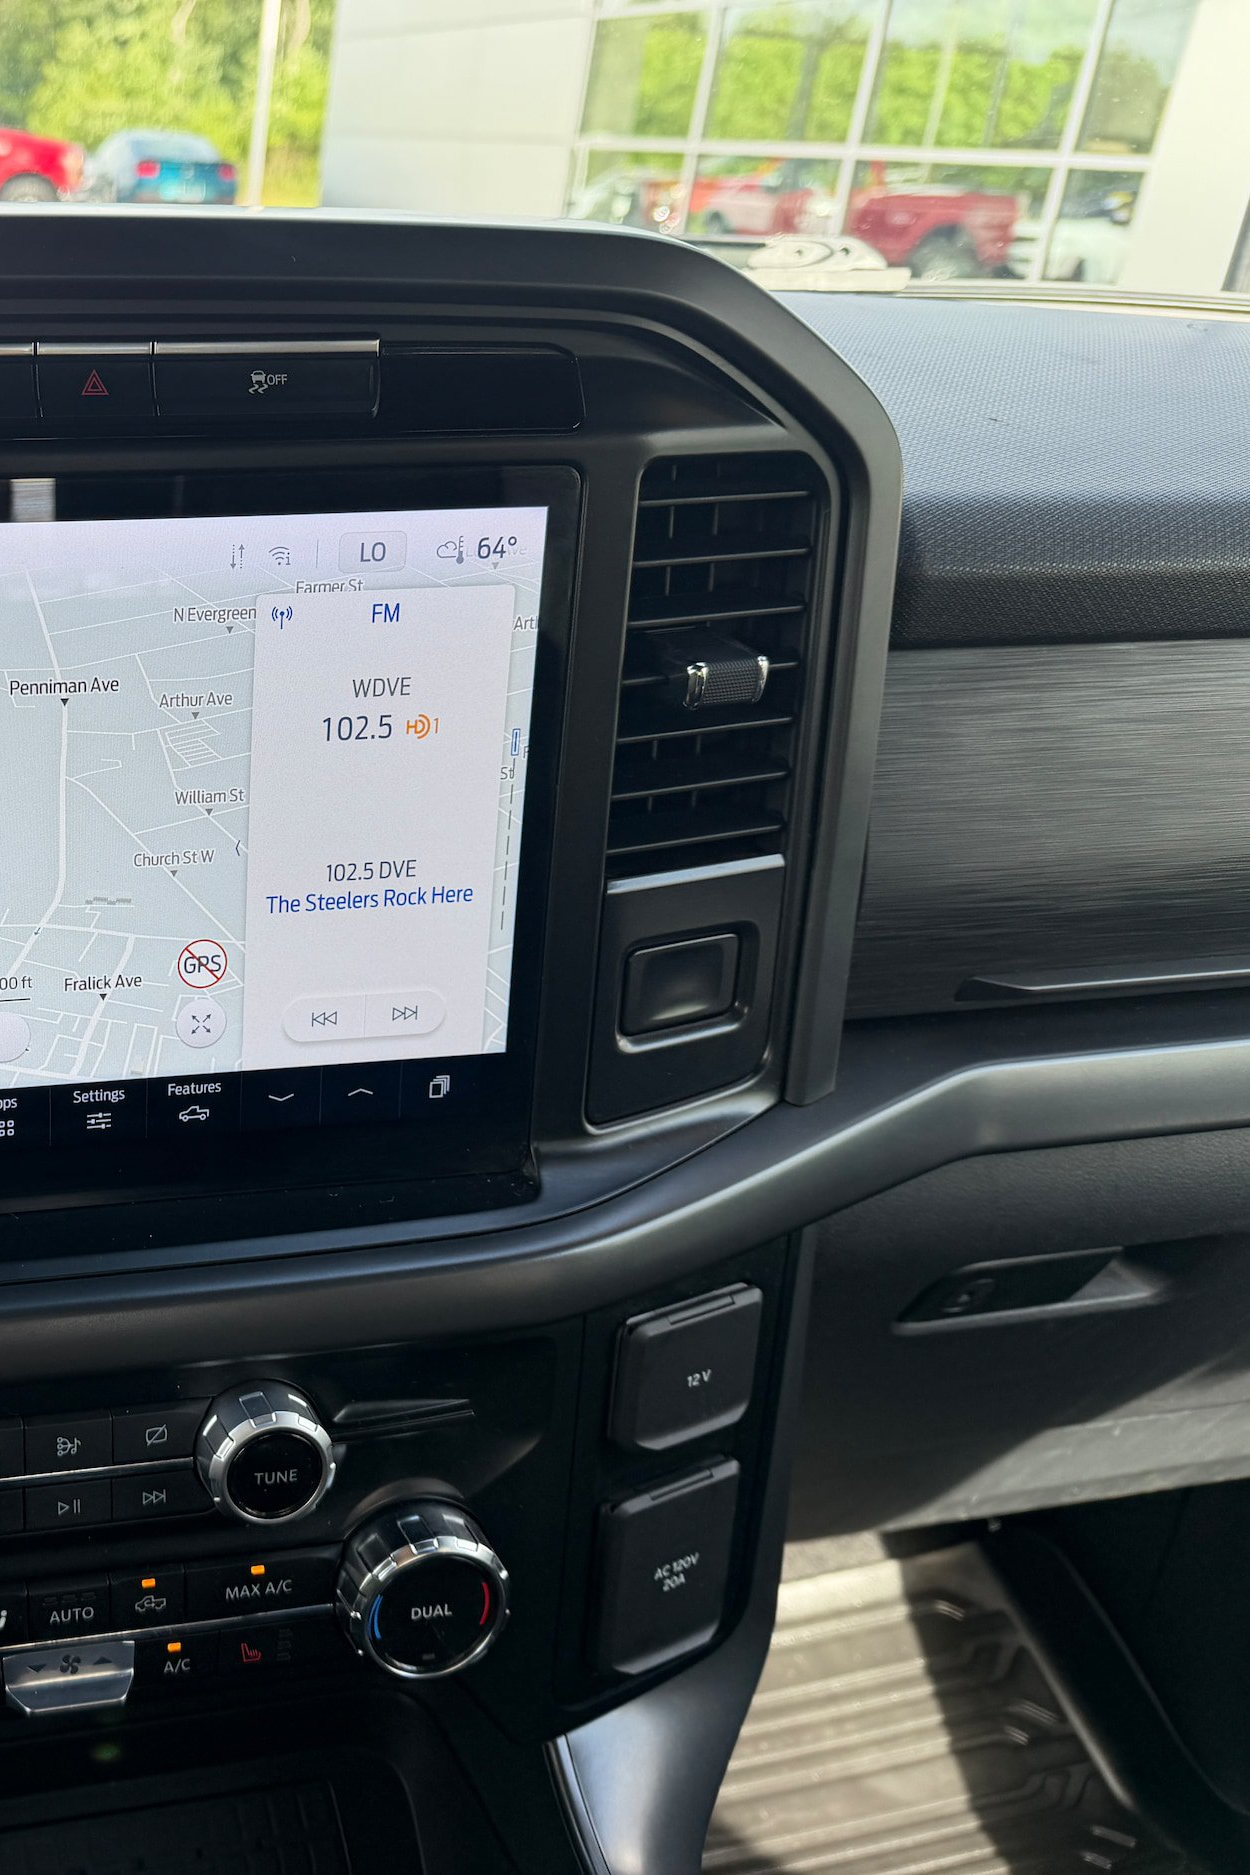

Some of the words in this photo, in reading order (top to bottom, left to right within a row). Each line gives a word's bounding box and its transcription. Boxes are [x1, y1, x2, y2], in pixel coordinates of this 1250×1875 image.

[267, 374, 287, 385] OFF
[360, 542, 386, 562] LO
[296, 581, 345, 593] Farmer
[349, 579, 363, 591] St
[174, 608, 183, 622] N
[188, 608, 256, 623] Evergreen
[371, 603, 401, 623] FM
[9, 680, 87, 696] Penniman
[90, 678, 119, 692] Ave
[352, 677, 412, 698] WDVE
[159, 694, 204, 708] Arthur
[207, 692, 232, 706] Ave
[322, 715, 393, 741] 102.5
[175, 790, 227, 804] William
[229, 789, 245, 802] St
[133, 852, 180, 868] Church
[182, 851, 198, 864] St
[200, 850, 215, 863] W
[327, 862, 374, 882] 102.5
[379, 859, 417, 879] DVE
[266, 896, 301, 914] The
[305, 892, 379, 912] Steelers
[384, 888, 427, 907] Rock
[432, 886, 473, 904] Here
[183, 955, 222, 974] GPS
[21, 976, 33, 989] ft
[64, 976, 112, 992] Fralick
[115, 974, 142, 989] Ave
[73, 1088, 125, 1104] Settings
[168, 1080, 222, 1096] Features
[253, 1468, 299, 1486] TUNE
[654, 1564, 670, 1581] AC
[673, 1552, 699, 1573] 120V
[225, 1584, 260, 1601] MAX
[265, 1580, 292, 1596] A/C
[663, 1573, 685, 1592] 20A
[50, 1607, 94, 1624] AUTO
[411, 1604, 452, 1621] DUAL
[163, 1659, 191, 1674] A/C
